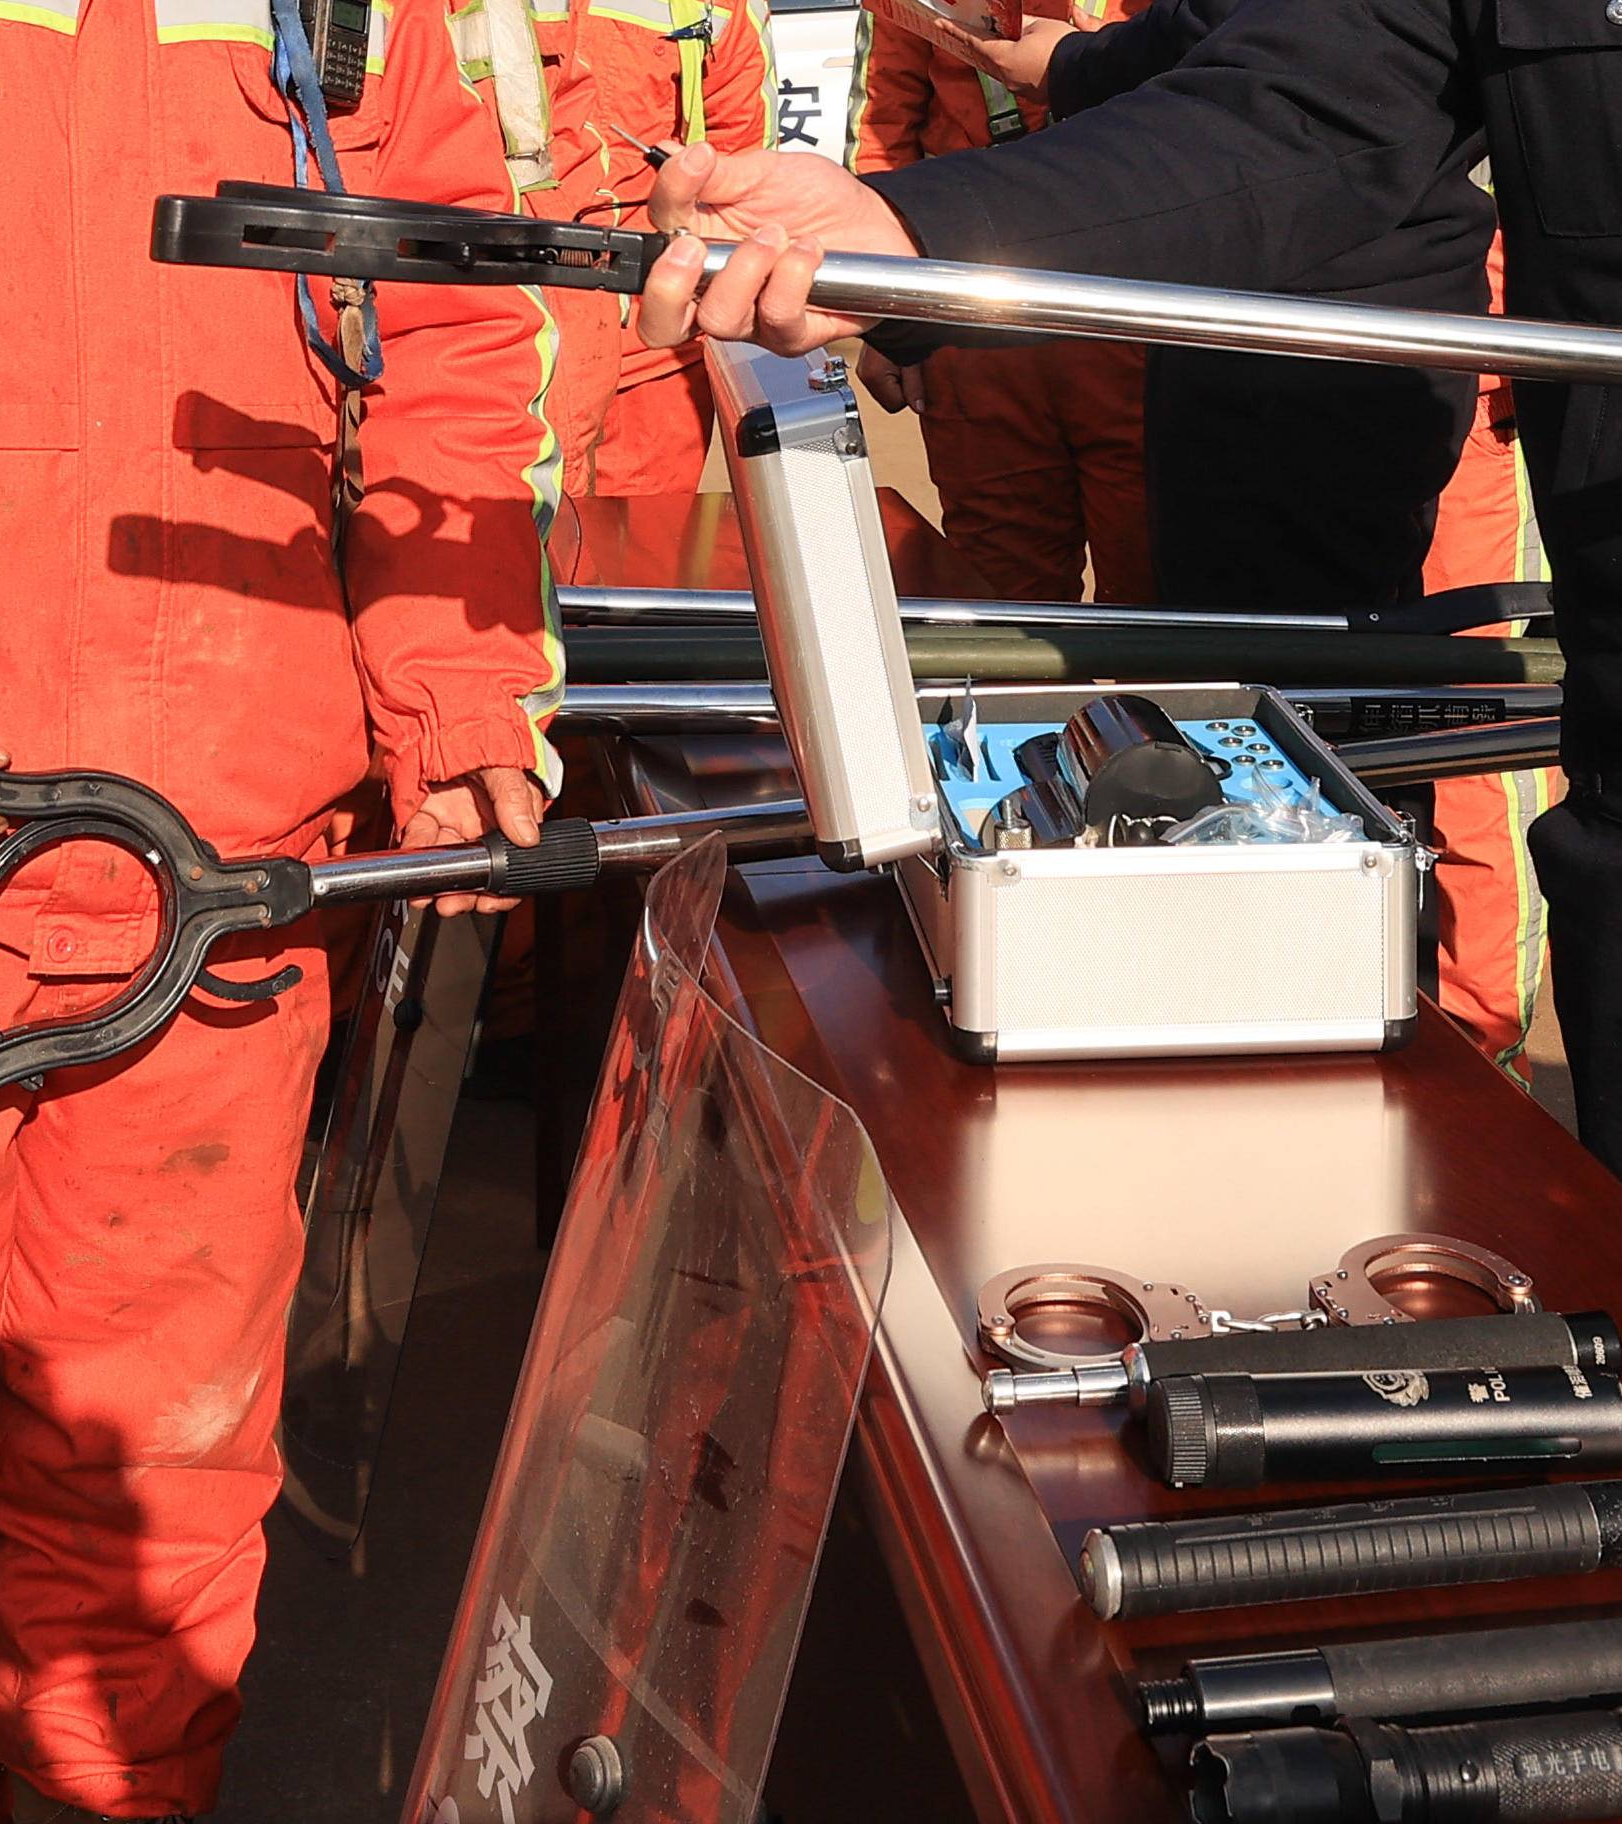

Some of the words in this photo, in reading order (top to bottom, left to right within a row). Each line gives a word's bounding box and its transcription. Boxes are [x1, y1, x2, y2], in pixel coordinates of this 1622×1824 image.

[778, 78, 822, 147] 安
[1521, 1744, 1611, 1778] 强光手电
